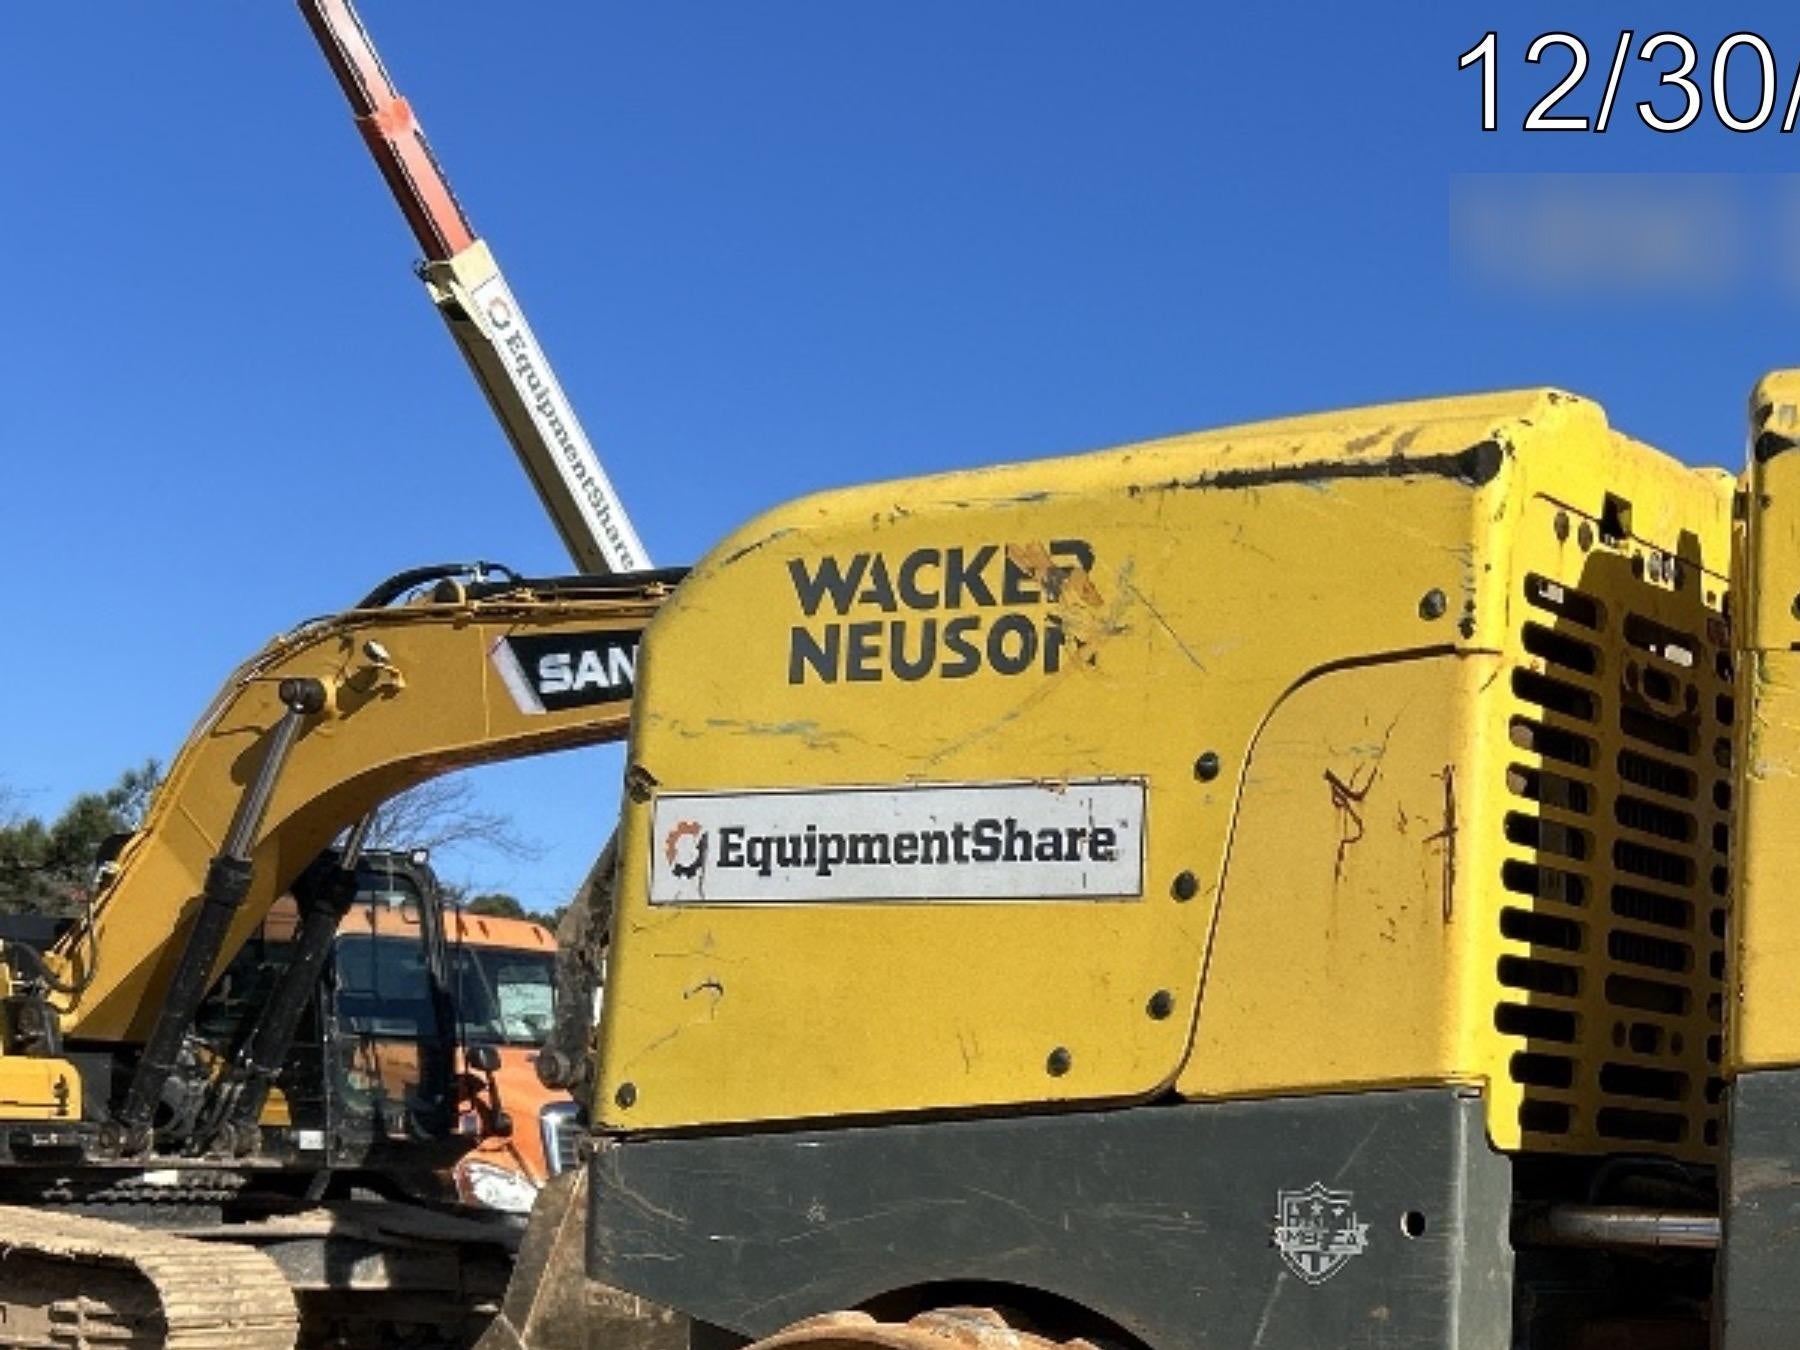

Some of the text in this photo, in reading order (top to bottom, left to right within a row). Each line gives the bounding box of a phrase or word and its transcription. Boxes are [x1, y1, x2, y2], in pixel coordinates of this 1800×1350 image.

[505, 329, 635, 571] EquipmentShare
[539, 645, 640, 694] SAN
[716, 818, 1119, 877] EquipmentShare
